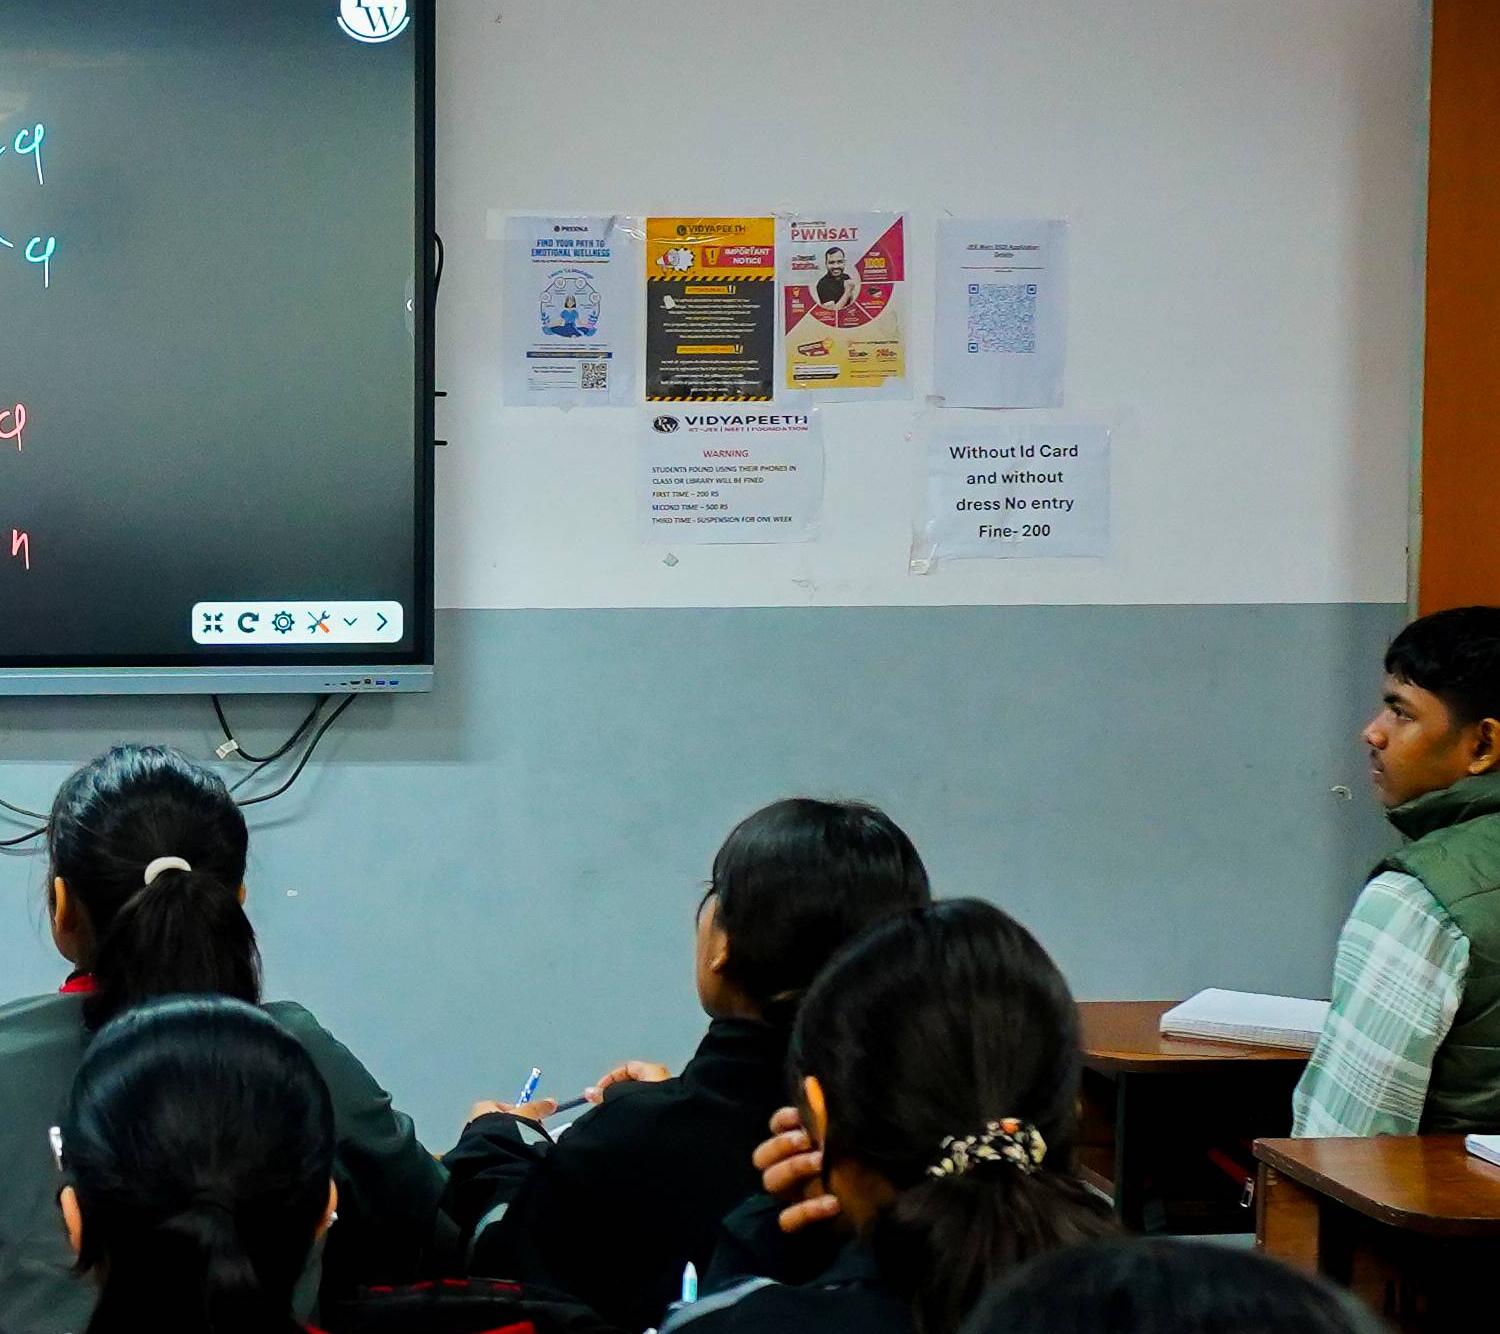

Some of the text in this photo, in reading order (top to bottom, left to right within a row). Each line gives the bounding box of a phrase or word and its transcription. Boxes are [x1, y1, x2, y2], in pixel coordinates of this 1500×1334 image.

[688, 224, 746, 233] VIDYAPEETH
[791, 227, 858, 241] PWNSAT
[536, 238, 554, 247] FIND
[556, 238, 574, 247] YOUR
[531, 248, 610, 257] EMOTIONAL WELLNESS
[724, 247, 770, 256] IMPORTANT
[732, 257, 762, 265] NOTICE
[684, 415, 808, 426] VIDYAPEETH
[703, 449, 749, 458] WARNING
[949, 444, 1079, 459] Without Id Card
[967, 470, 1064, 484] and without
[956, 497, 1074, 512] dress No entry
[979, 524, 1050, 538] Fine- 200
